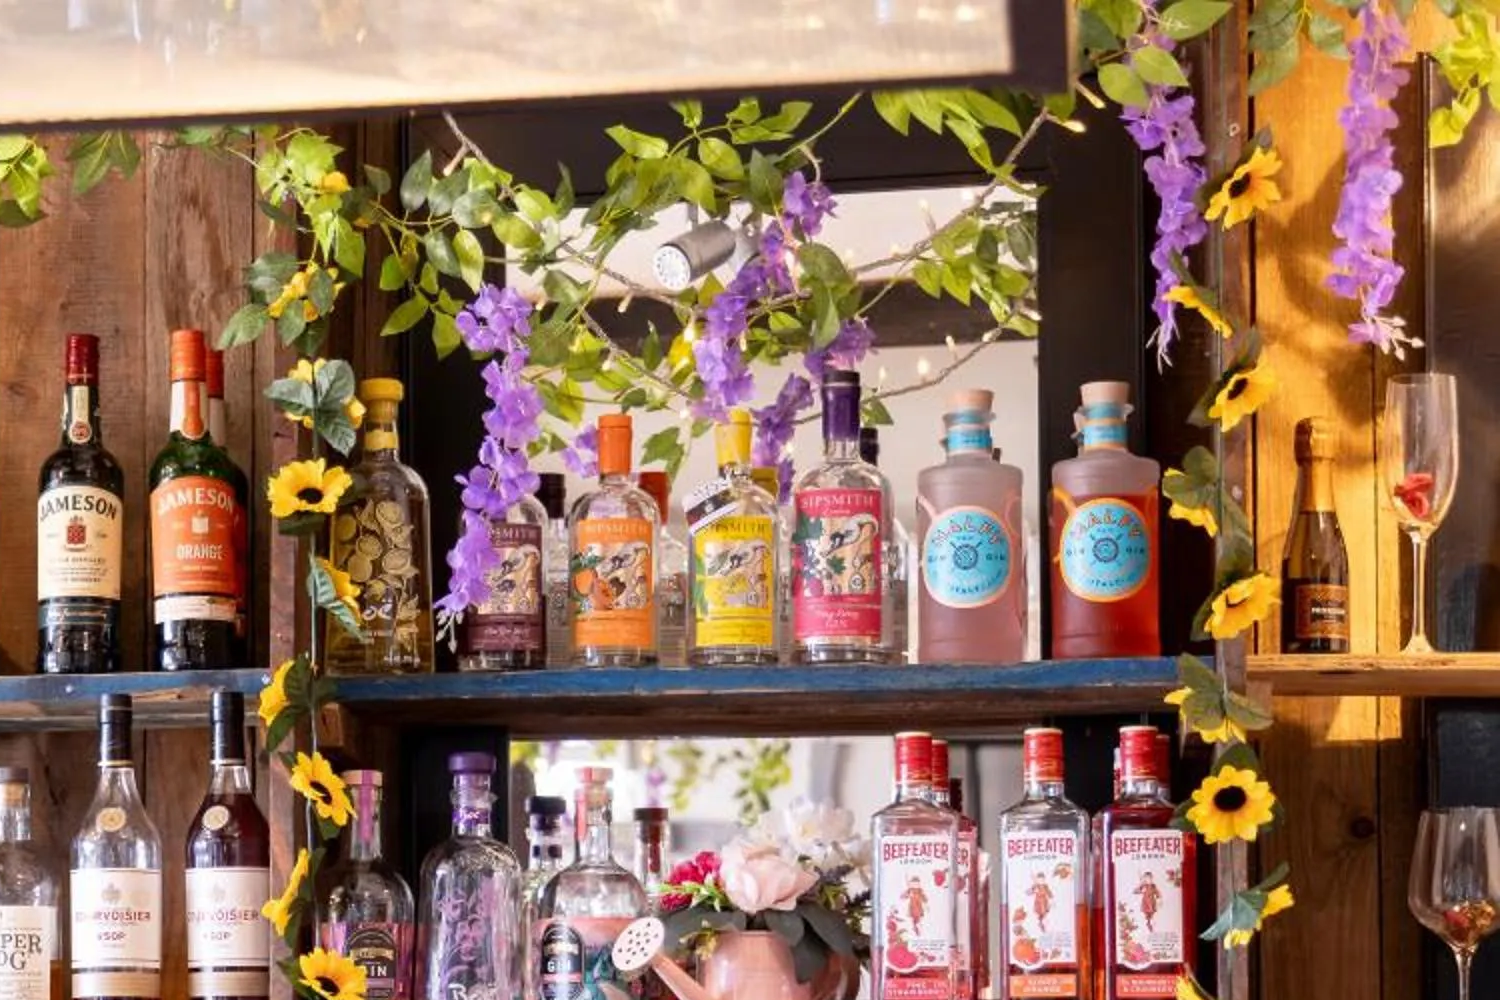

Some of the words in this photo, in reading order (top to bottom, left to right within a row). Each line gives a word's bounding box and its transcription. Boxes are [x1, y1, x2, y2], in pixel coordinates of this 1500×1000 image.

[40, 494, 118, 521] JAMESON
[158, 487, 235, 517] JAMESON
[802, 492, 873, 509] SIPSMITH
[176, 543, 223, 561] ORANGE
[883, 840, 950, 863] BEEFEATER
[1007, 837, 1074, 858] BEEFEATER
[1114, 836, 1182, 858] BEEFEATER
[76, 910, 151, 923] RVOISIER
